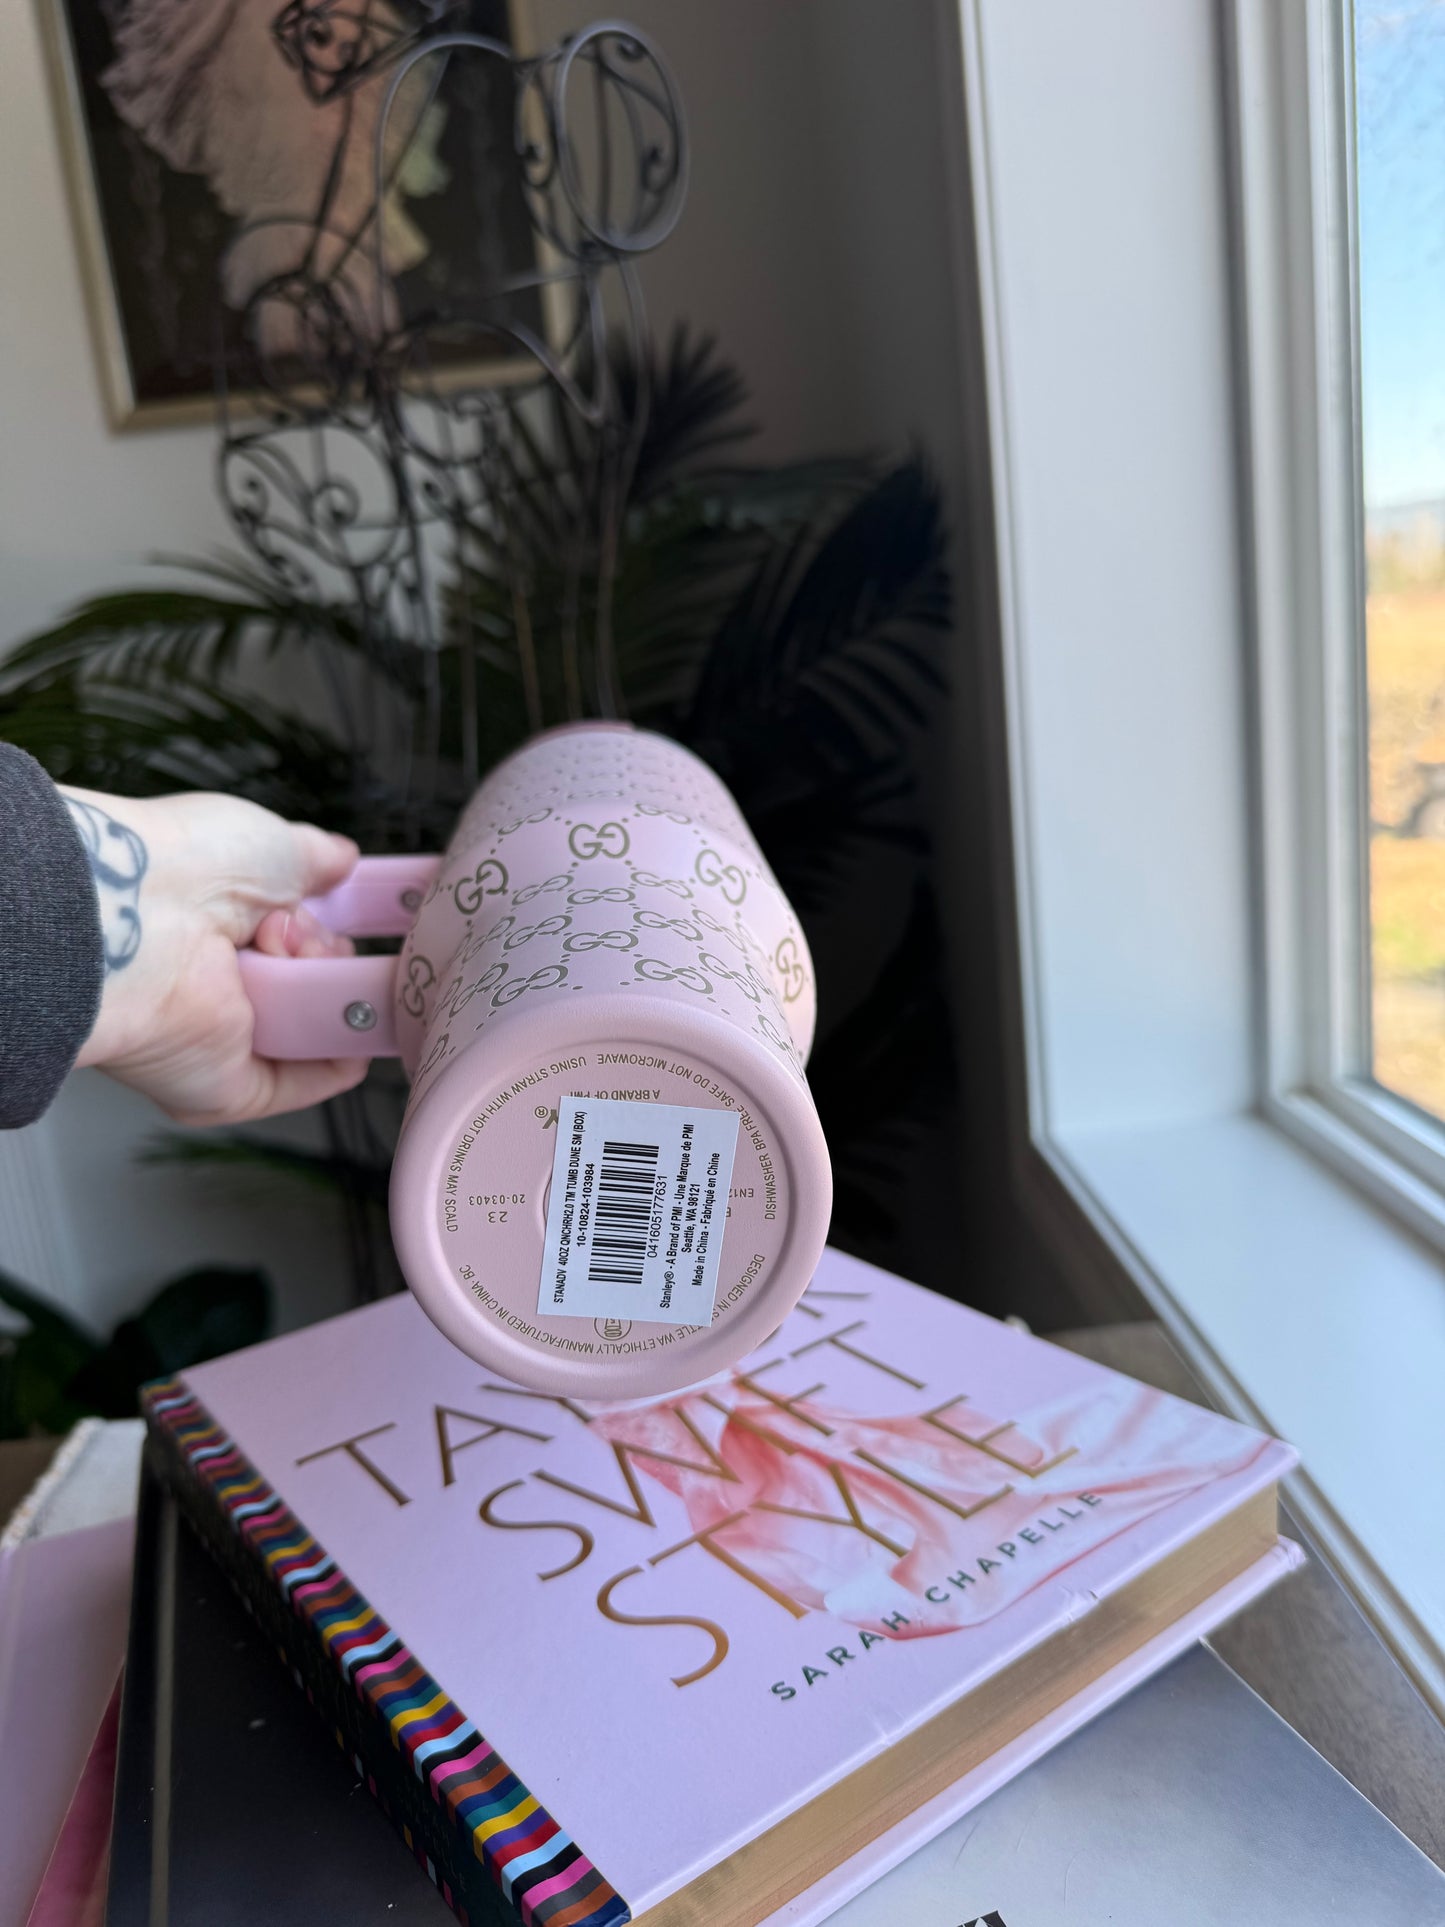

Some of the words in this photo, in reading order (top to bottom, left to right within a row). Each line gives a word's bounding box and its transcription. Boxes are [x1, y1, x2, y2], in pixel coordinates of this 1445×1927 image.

[550, 1056, 587, 1075] USING
[597, 1053, 667, 1070] MICROWAVE
[668, 1063, 693, 1080] NOT
[510, 1068, 549, 1096] STRAW
[693, 1073, 711, 1089] DO
[486, 1091, 513, 1115] WITH
[611, 1090, 651, 1100] BRAND
[652, 1090, 661, 1100] A
[708, 1083, 735, 1107] SAFE
[469, 1112, 490, 1136] HOT
[573, 1111, 587, 1132] (BOX)
[682, 1123, 694, 1139] PMI
[571, 1133, 583, 1146] SM
[681, 1141, 692, 1151] de
[750, 1130, 767, 1151] BPA
[449, 1134, 475, 1173] DRINKS
[569, 1146, 581, 1168] DUNE
[707, 1152, 720, 1176] Chine
[566, 1169, 578, 1189] TUMB
[676, 1153, 692, 1183] Marque
[444, 1174, 459, 1196] MAY
[673, 1184, 686, 1199] Une
[707, 1178, 717, 1187] en
[759, 1153, 777, 1220] DISHWASHER
[565, 1191, 576, 1202] TM
[577, 1163, 595, 1247] 10-10824-103984
[687, 1183, 701, 1206] 98121
[444, 1198, 459, 1233] SCALD
[487, 1211, 508, 1223] 23
[647, 1175, 668, 1258] 041605177631
[671, 1206, 682, 1221] PMI
[685, 1208, 698, 1221] WA
[700, 1190, 716, 1224] Fabriqué
[671, 1223, 681, 1232] of
[681, 1223, 697, 1253] Seattle,
[666, 1232, 679, 1257] Brand
[696, 1231, 709, 1254] China
[459, 1264, 475, 1280] BC
[691, 1264, 704, 1286] Made
[727, 1253, 766, 1302] DESIGNED
[554, 1268, 567, 1303] STANADV
[495, 1306, 510, 1320] IN
[719, 1299, 731, 1312] IN
[506, 1315, 594, 1355] MANUFACTURED
[656, 1333, 675, 1347] WA
[596, 1339, 656, 1355] ETHICALLY
[479, 1320, 927, 1581] SWIFT
[596, 1395, 1080, 1687] STYLE
[770, 1610, 911, 1701] SARAH
[924, 1490, 1103, 1604] CHAPELLE
